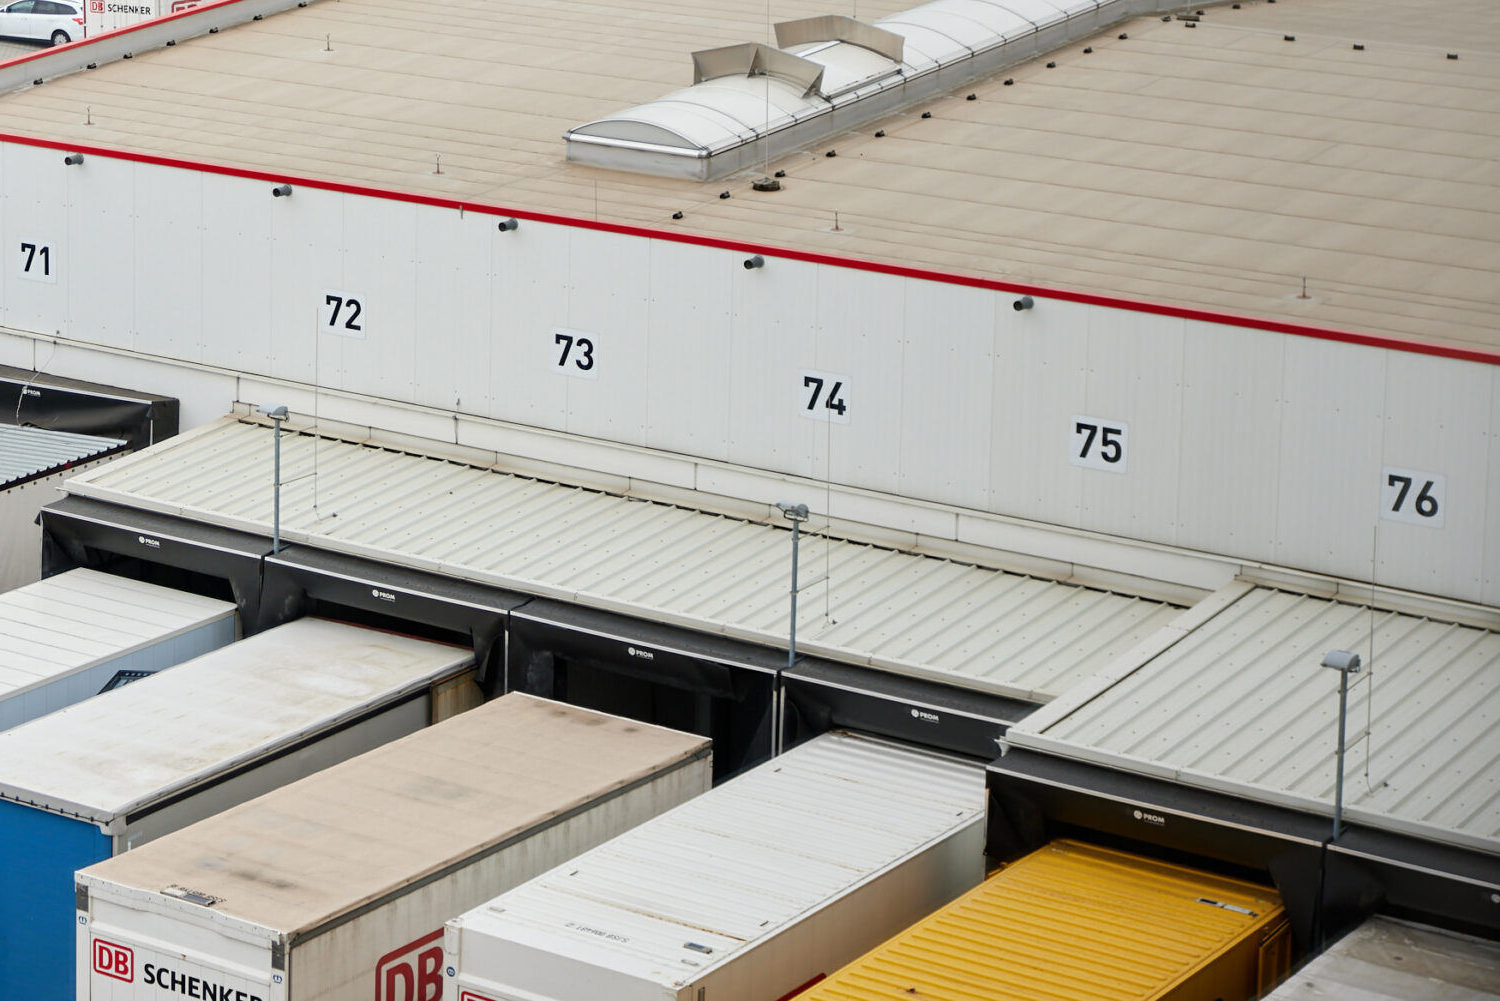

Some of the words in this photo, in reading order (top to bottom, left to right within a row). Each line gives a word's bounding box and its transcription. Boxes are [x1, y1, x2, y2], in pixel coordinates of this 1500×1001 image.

[107, 3, 151, 15] SCHENKER
[22, 243, 49, 275] 71
[327, 295, 361, 330] 72
[556, 334, 593, 370] 73
[804, 376, 846, 415] 74
[1076, 423, 1121, 463] 75
[1389, 475, 1438, 517] 76
[145, 538, 160, 546] PROM
[379, 591, 396, 600] PROM
[635, 649, 654, 659] PROM
[919, 711, 939, 721] PROM
[1143, 812, 1165, 824] PROM
[98, 947, 130, 977] DB
[143, 962, 262, 1001] SCHENK
[385, 945, 444, 1001] DB
